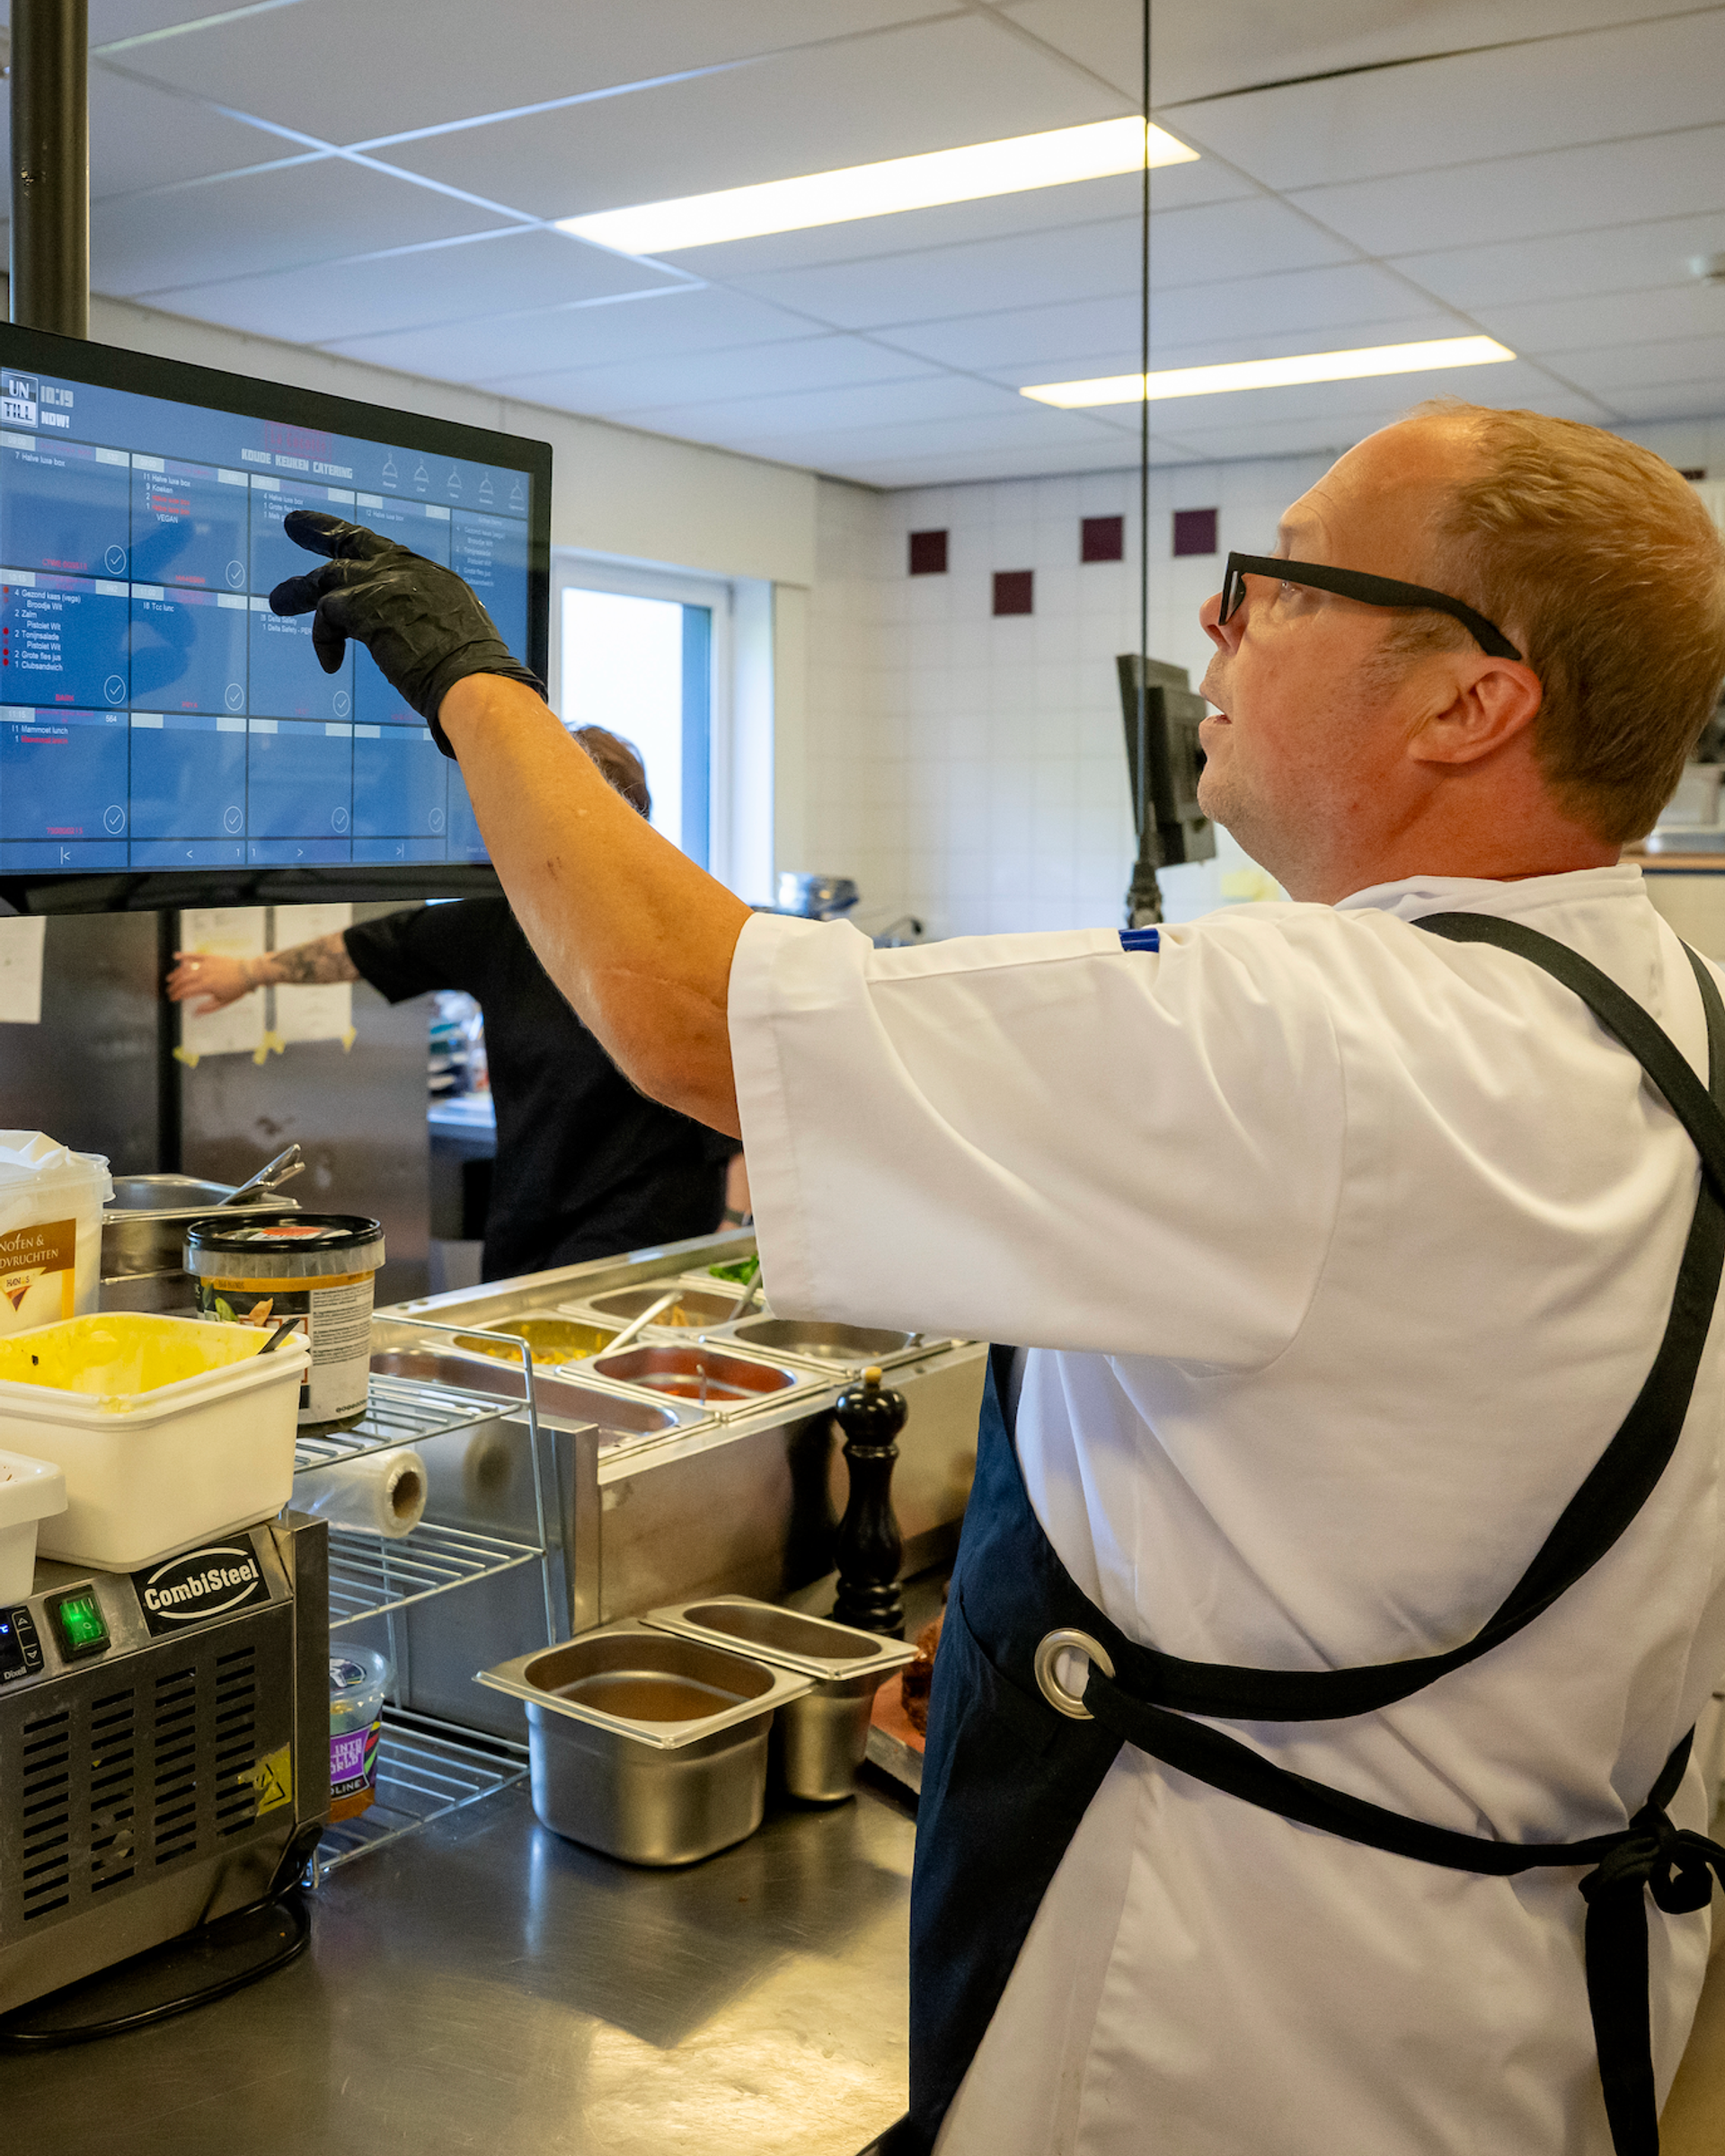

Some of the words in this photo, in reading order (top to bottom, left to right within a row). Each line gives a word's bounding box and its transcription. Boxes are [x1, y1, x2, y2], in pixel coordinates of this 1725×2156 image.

[8, 379, 30, 399] UN
[4, 402, 33, 421] TILL
[41, 411, 70, 429] NOW!
[54, 456, 66, 466] box
[275, 455, 309, 472] KEUKEN
[313, 461, 352, 479] CATERING
[152, 473, 168, 484] Halve
[181, 479, 190, 487] box
[146, 482, 151, 490] 9
[156, 513, 179, 524] VEGAN
[22, 589, 46, 598] Gezond
[27, 600, 51, 611] Broodje
[52, 603, 63, 611] Wit
[14, 610, 19, 618] 2
[22, 610, 38, 619] Zalm
[27, 621, 50, 630] Pistolet
[50, 623, 62, 631] Wit
[22, 630, 60, 641] Tonijnsalade
[27, 641, 50, 651] Pistolet
[50, 643, 62, 651] Wit
[14, 650, 19, 658] 2
[22, 650, 40, 660] Grote
[52, 653, 62, 662] jus
[22, 660, 64, 671] Clubsandwich
[21, 726, 51, 735] Mammoet
[51, 727, 68, 735] lunch
[36, 1234, 45, 1247] &
[6, 1276, 31, 1287] HANS
[144, 1558, 260, 1611] CombiSteel
